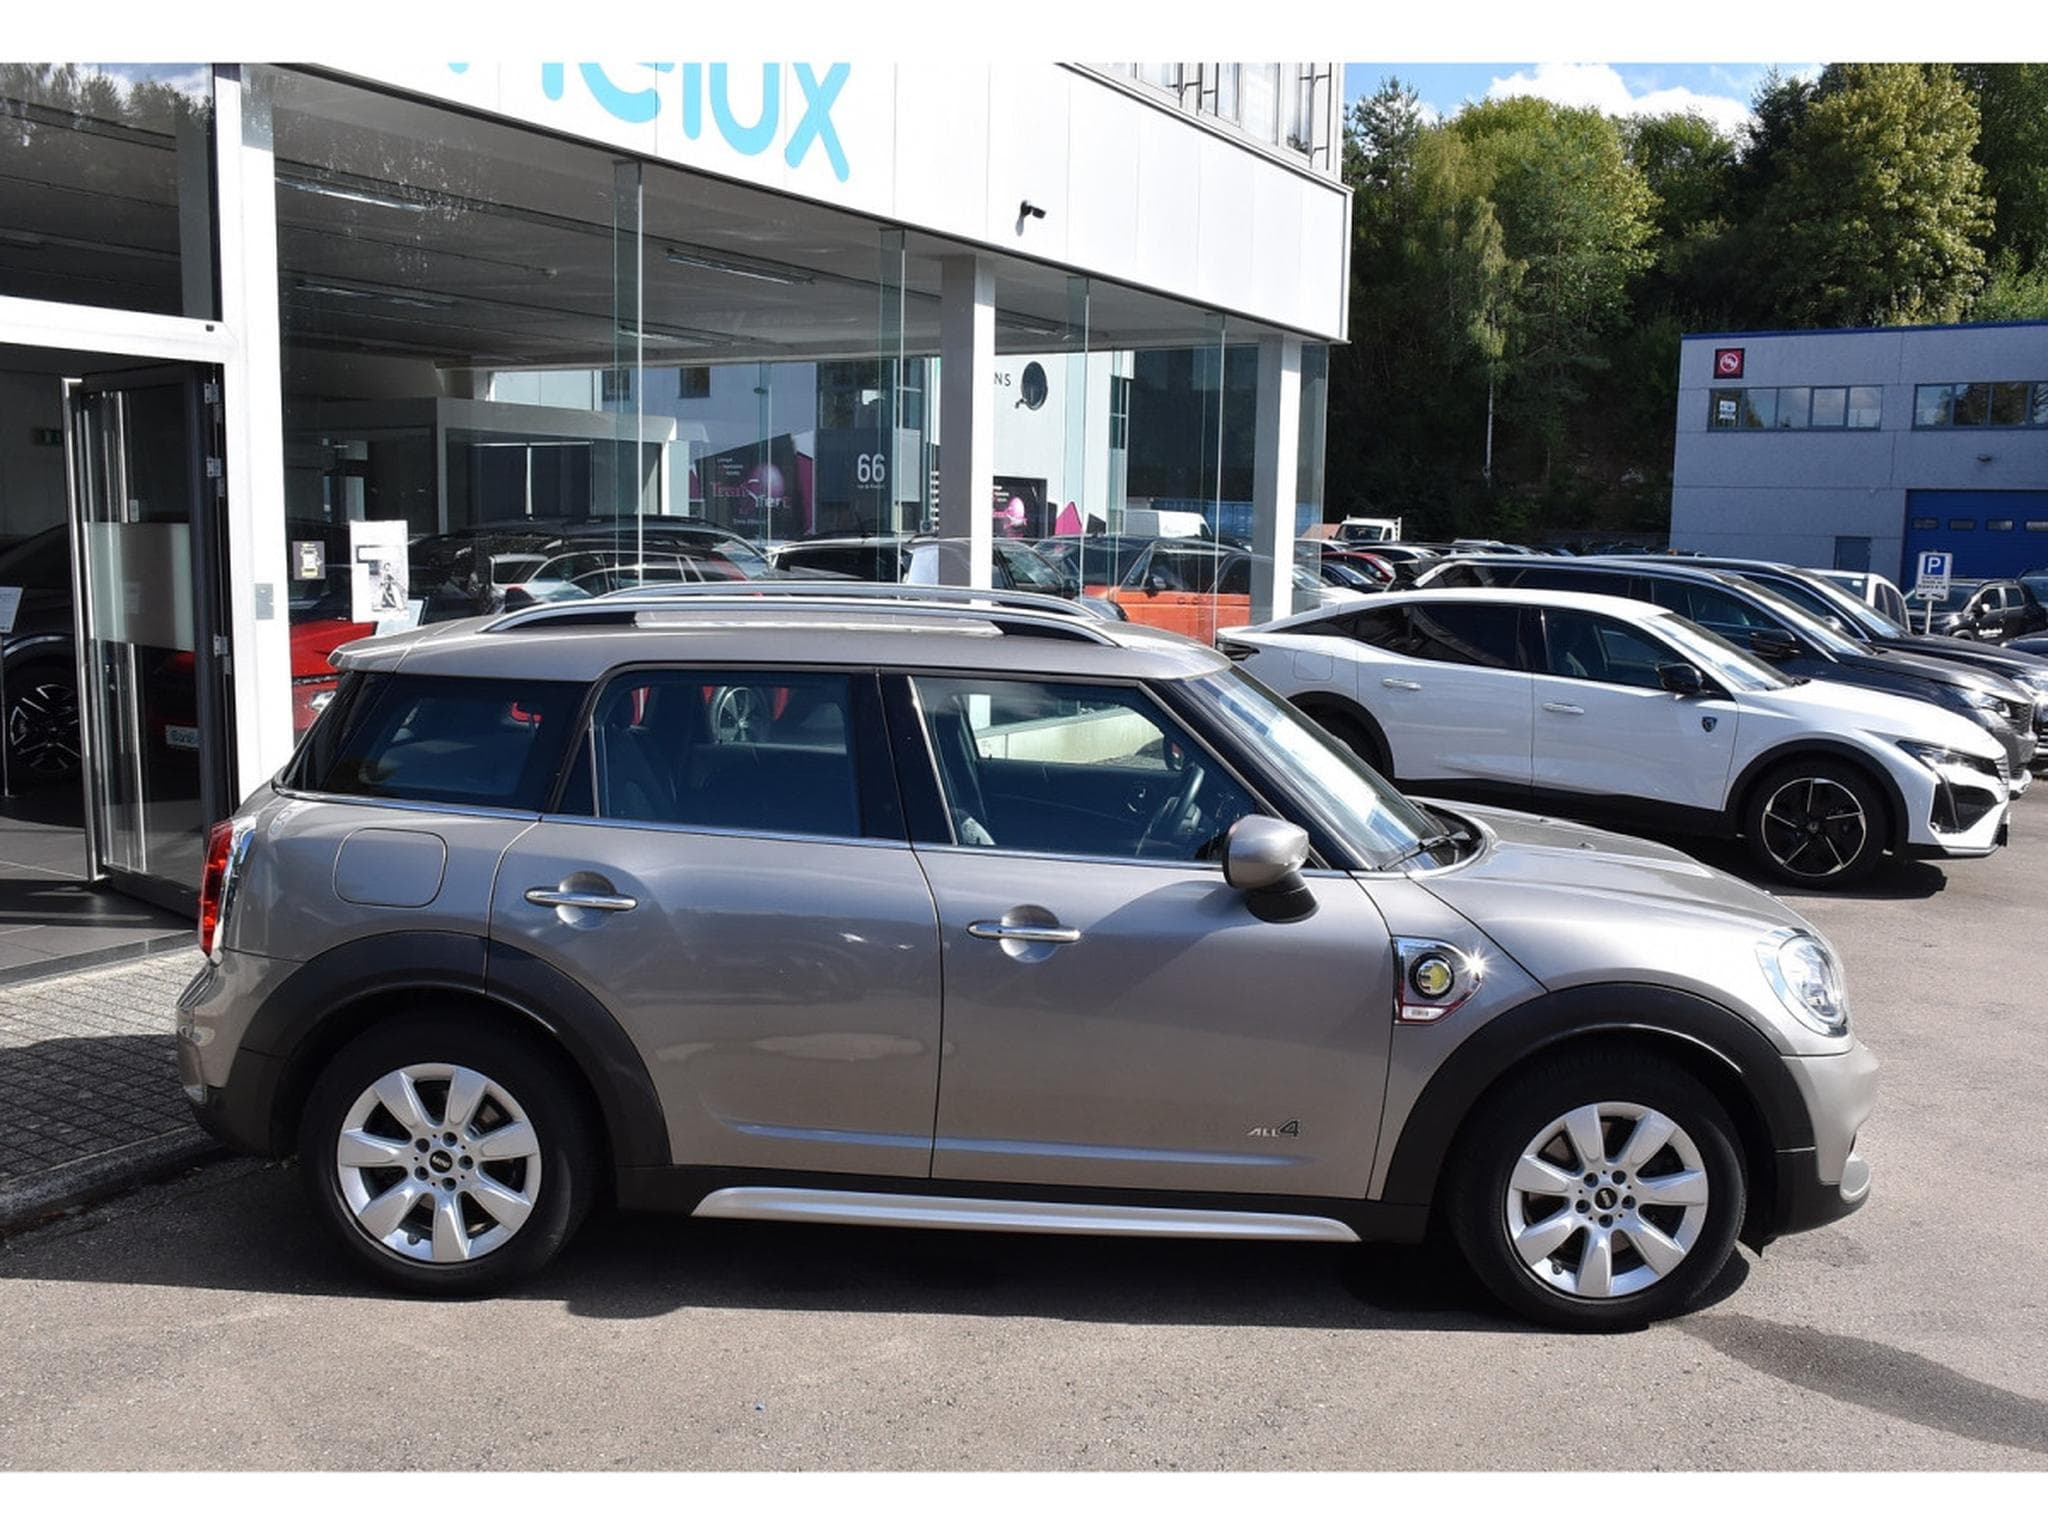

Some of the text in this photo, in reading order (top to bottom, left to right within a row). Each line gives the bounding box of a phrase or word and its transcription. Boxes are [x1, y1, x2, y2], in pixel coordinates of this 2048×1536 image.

[993, 372, 1012, 387] NS
[857, 453, 885, 483] 66
[1927, 557, 1942, 574] P
